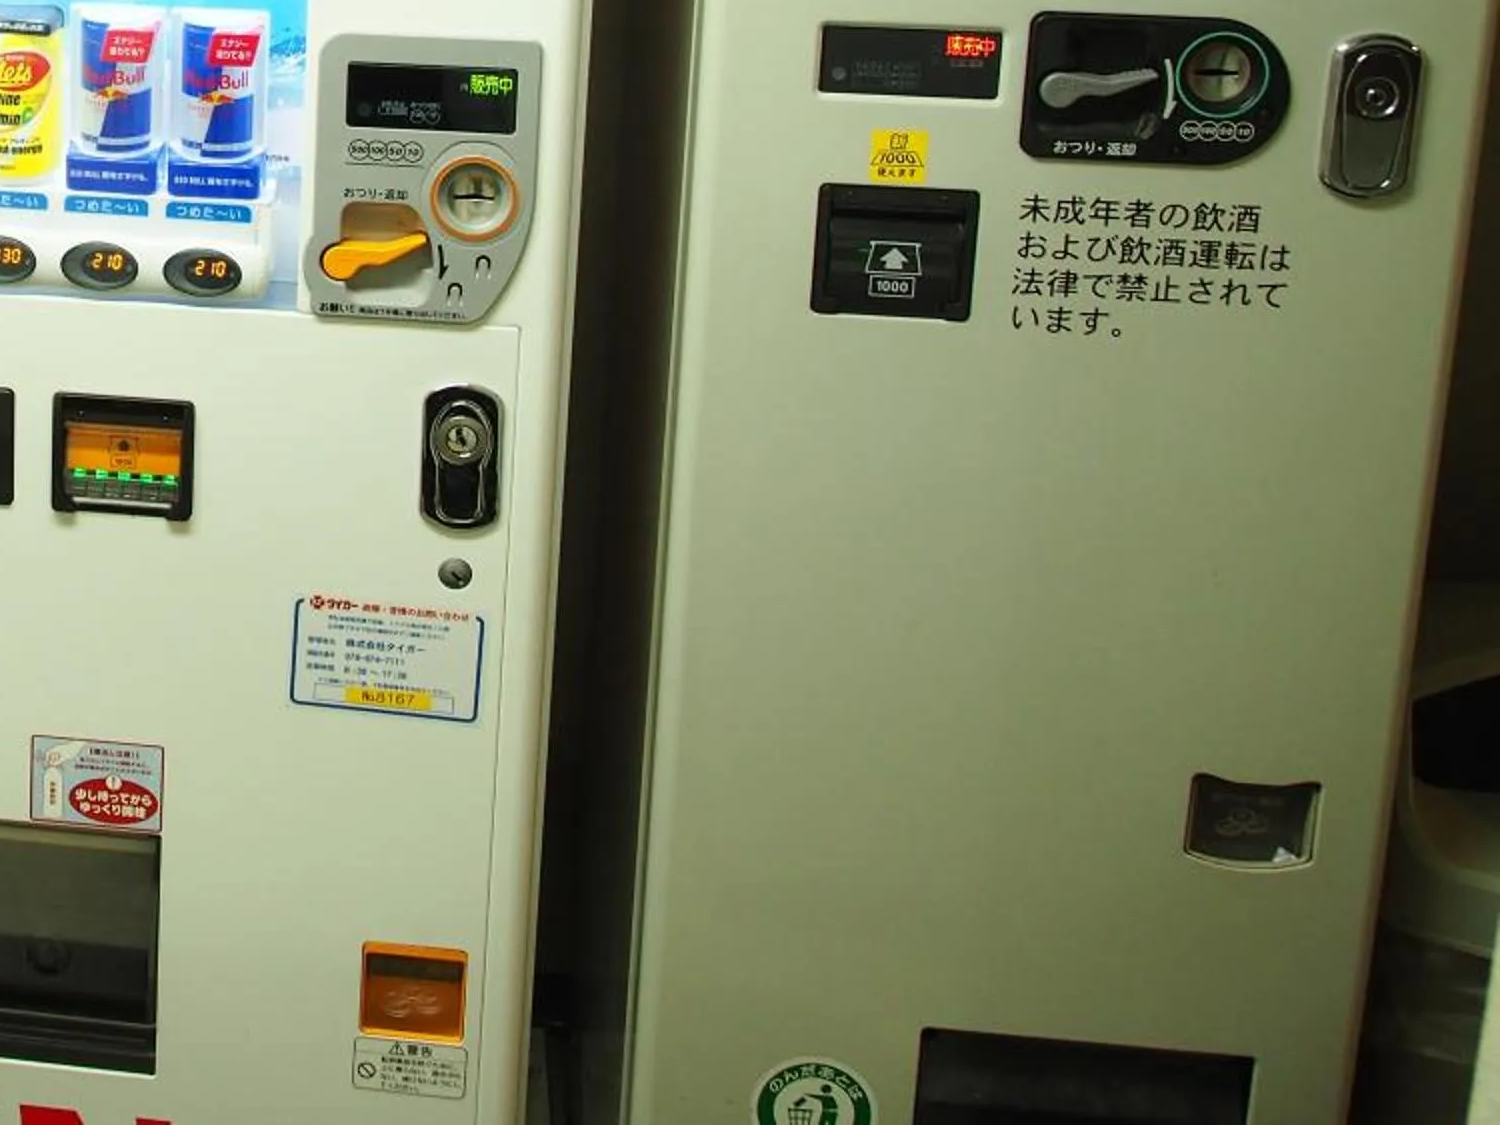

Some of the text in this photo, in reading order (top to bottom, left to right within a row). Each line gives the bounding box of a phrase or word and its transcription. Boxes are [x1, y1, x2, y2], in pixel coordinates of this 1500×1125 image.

[112, 69, 145, 86] Bull
[219, 72, 249, 90] Bull
[1019, 194, 1262, 234] 未成年者の飲酒
[1016, 230, 1291, 272] および飲酒運転は
[91, 252, 123, 271] 210
[195, 260, 227, 279] 210
[877, 280, 909, 292] 1000
[1011, 267, 1289, 308] 法律で禁止されて
[1012, 306, 1122, 338] います。
